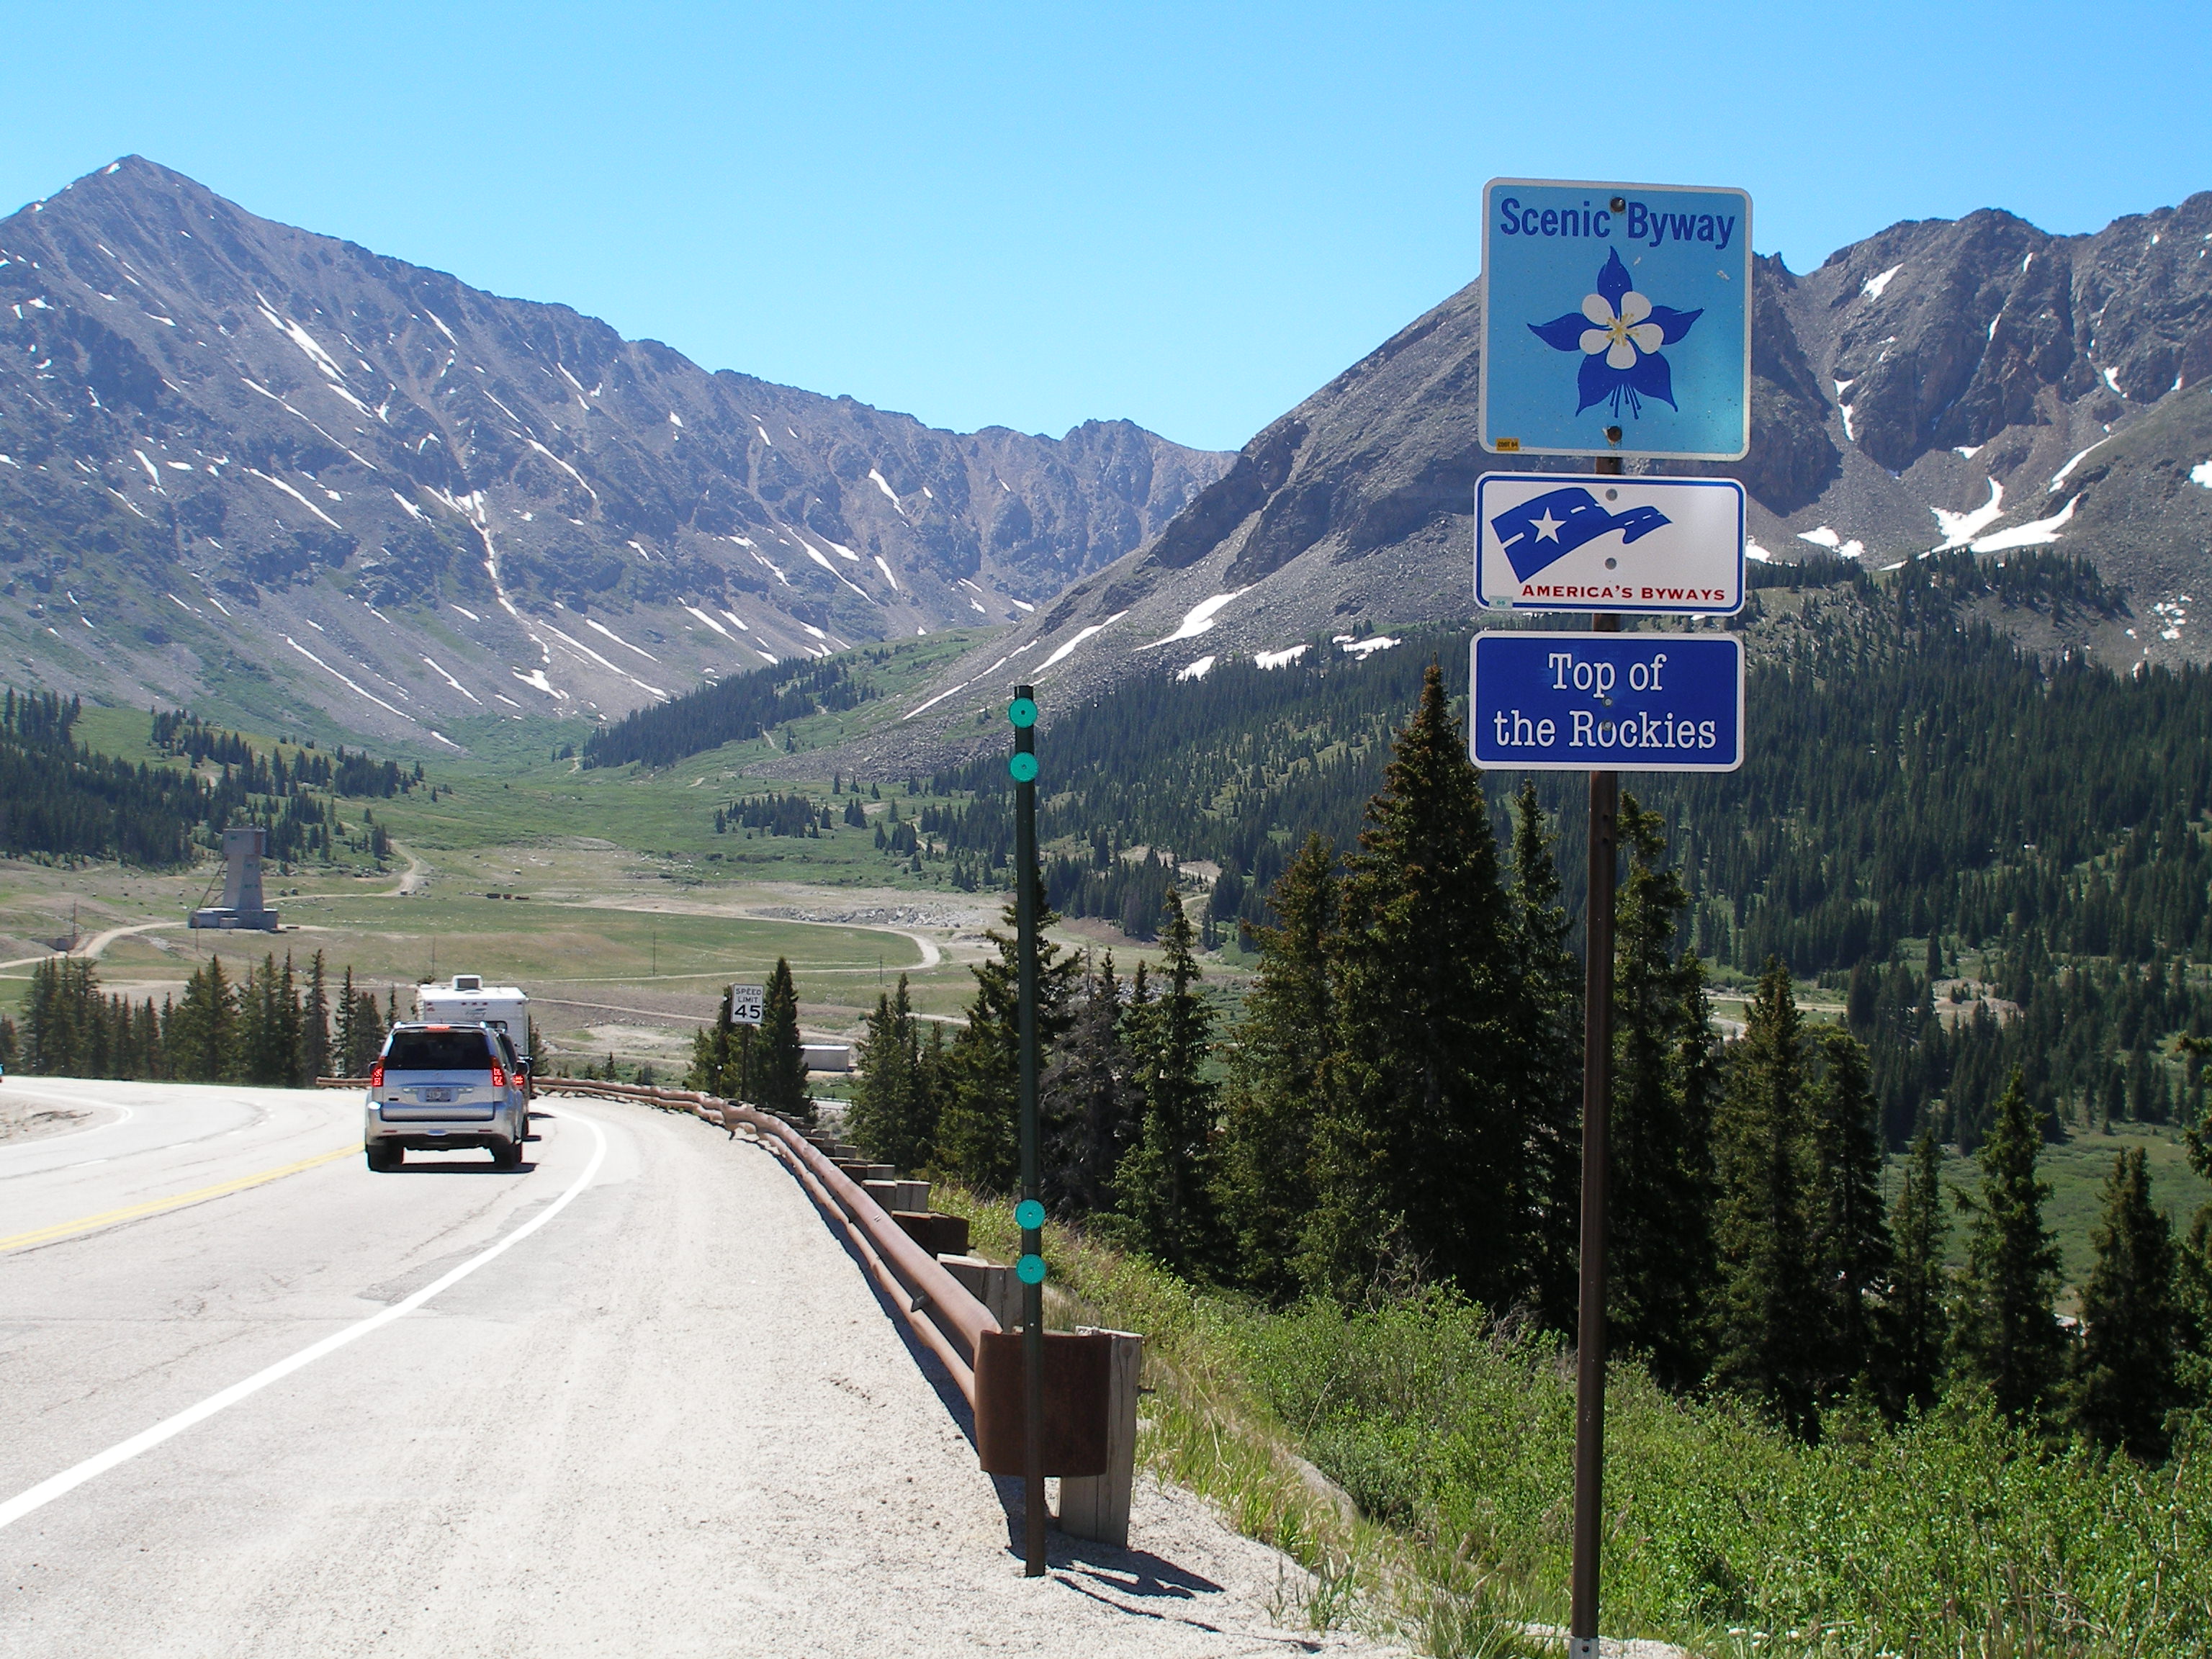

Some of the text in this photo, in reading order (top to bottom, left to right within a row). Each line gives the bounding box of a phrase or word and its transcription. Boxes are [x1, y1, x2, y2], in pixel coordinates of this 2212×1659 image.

[1500, 197, 1735, 250] Scenic Byway
[1521, 585, 1725, 601] AMERICA'S BYWAYS
[1548, 652, 1668, 698] Top of
[1493, 709, 1717, 750] the Rockies
[734, 1004, 761, 1019] 45
